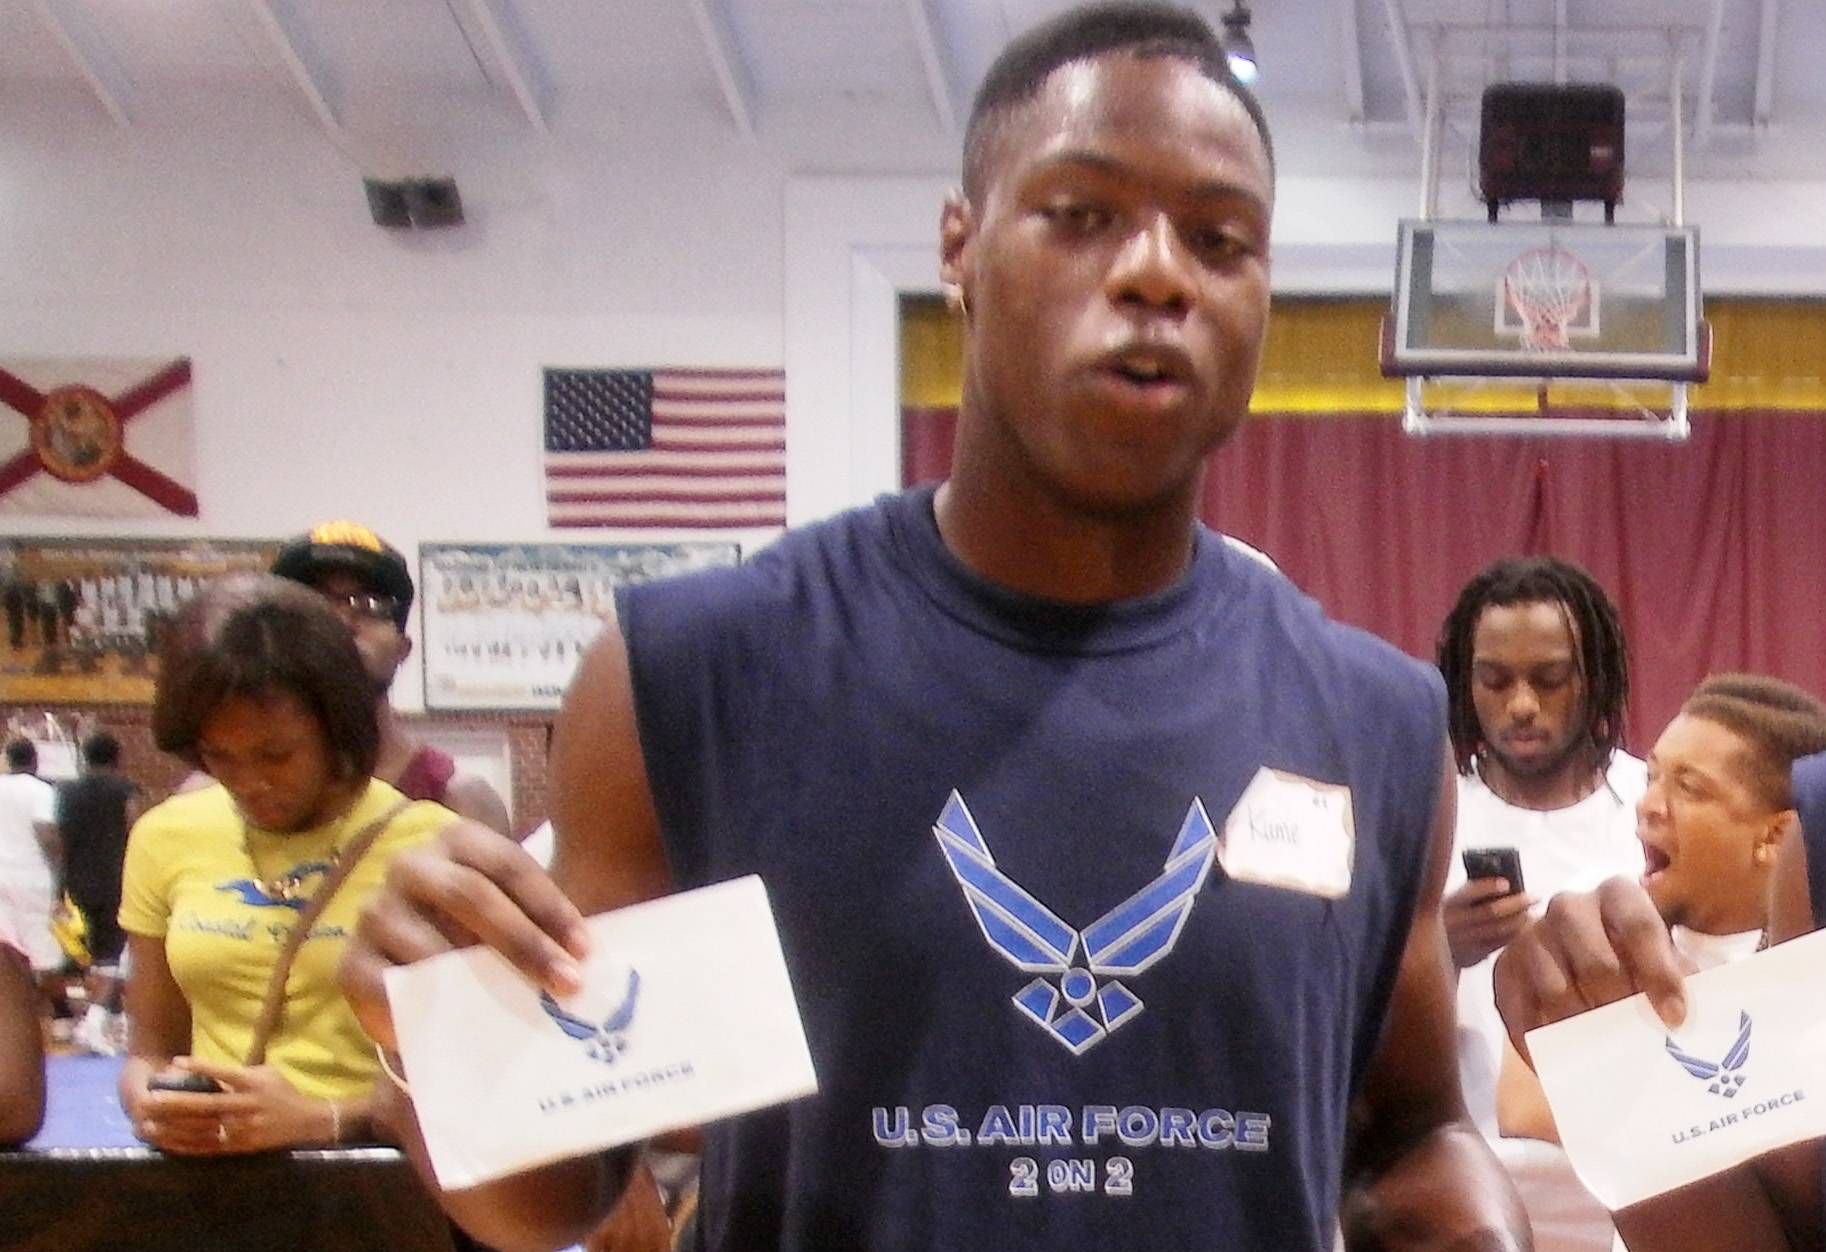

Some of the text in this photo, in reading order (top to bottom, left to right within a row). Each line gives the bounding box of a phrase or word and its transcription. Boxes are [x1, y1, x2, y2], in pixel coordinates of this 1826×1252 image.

[872, 1104, 1271, 1151] U.S. AIR FORCE
[1671, 1089, 1806, 1144] U.S. AIR FORCE
[1009, 1156, 1134, 1196] 2 ON 2
